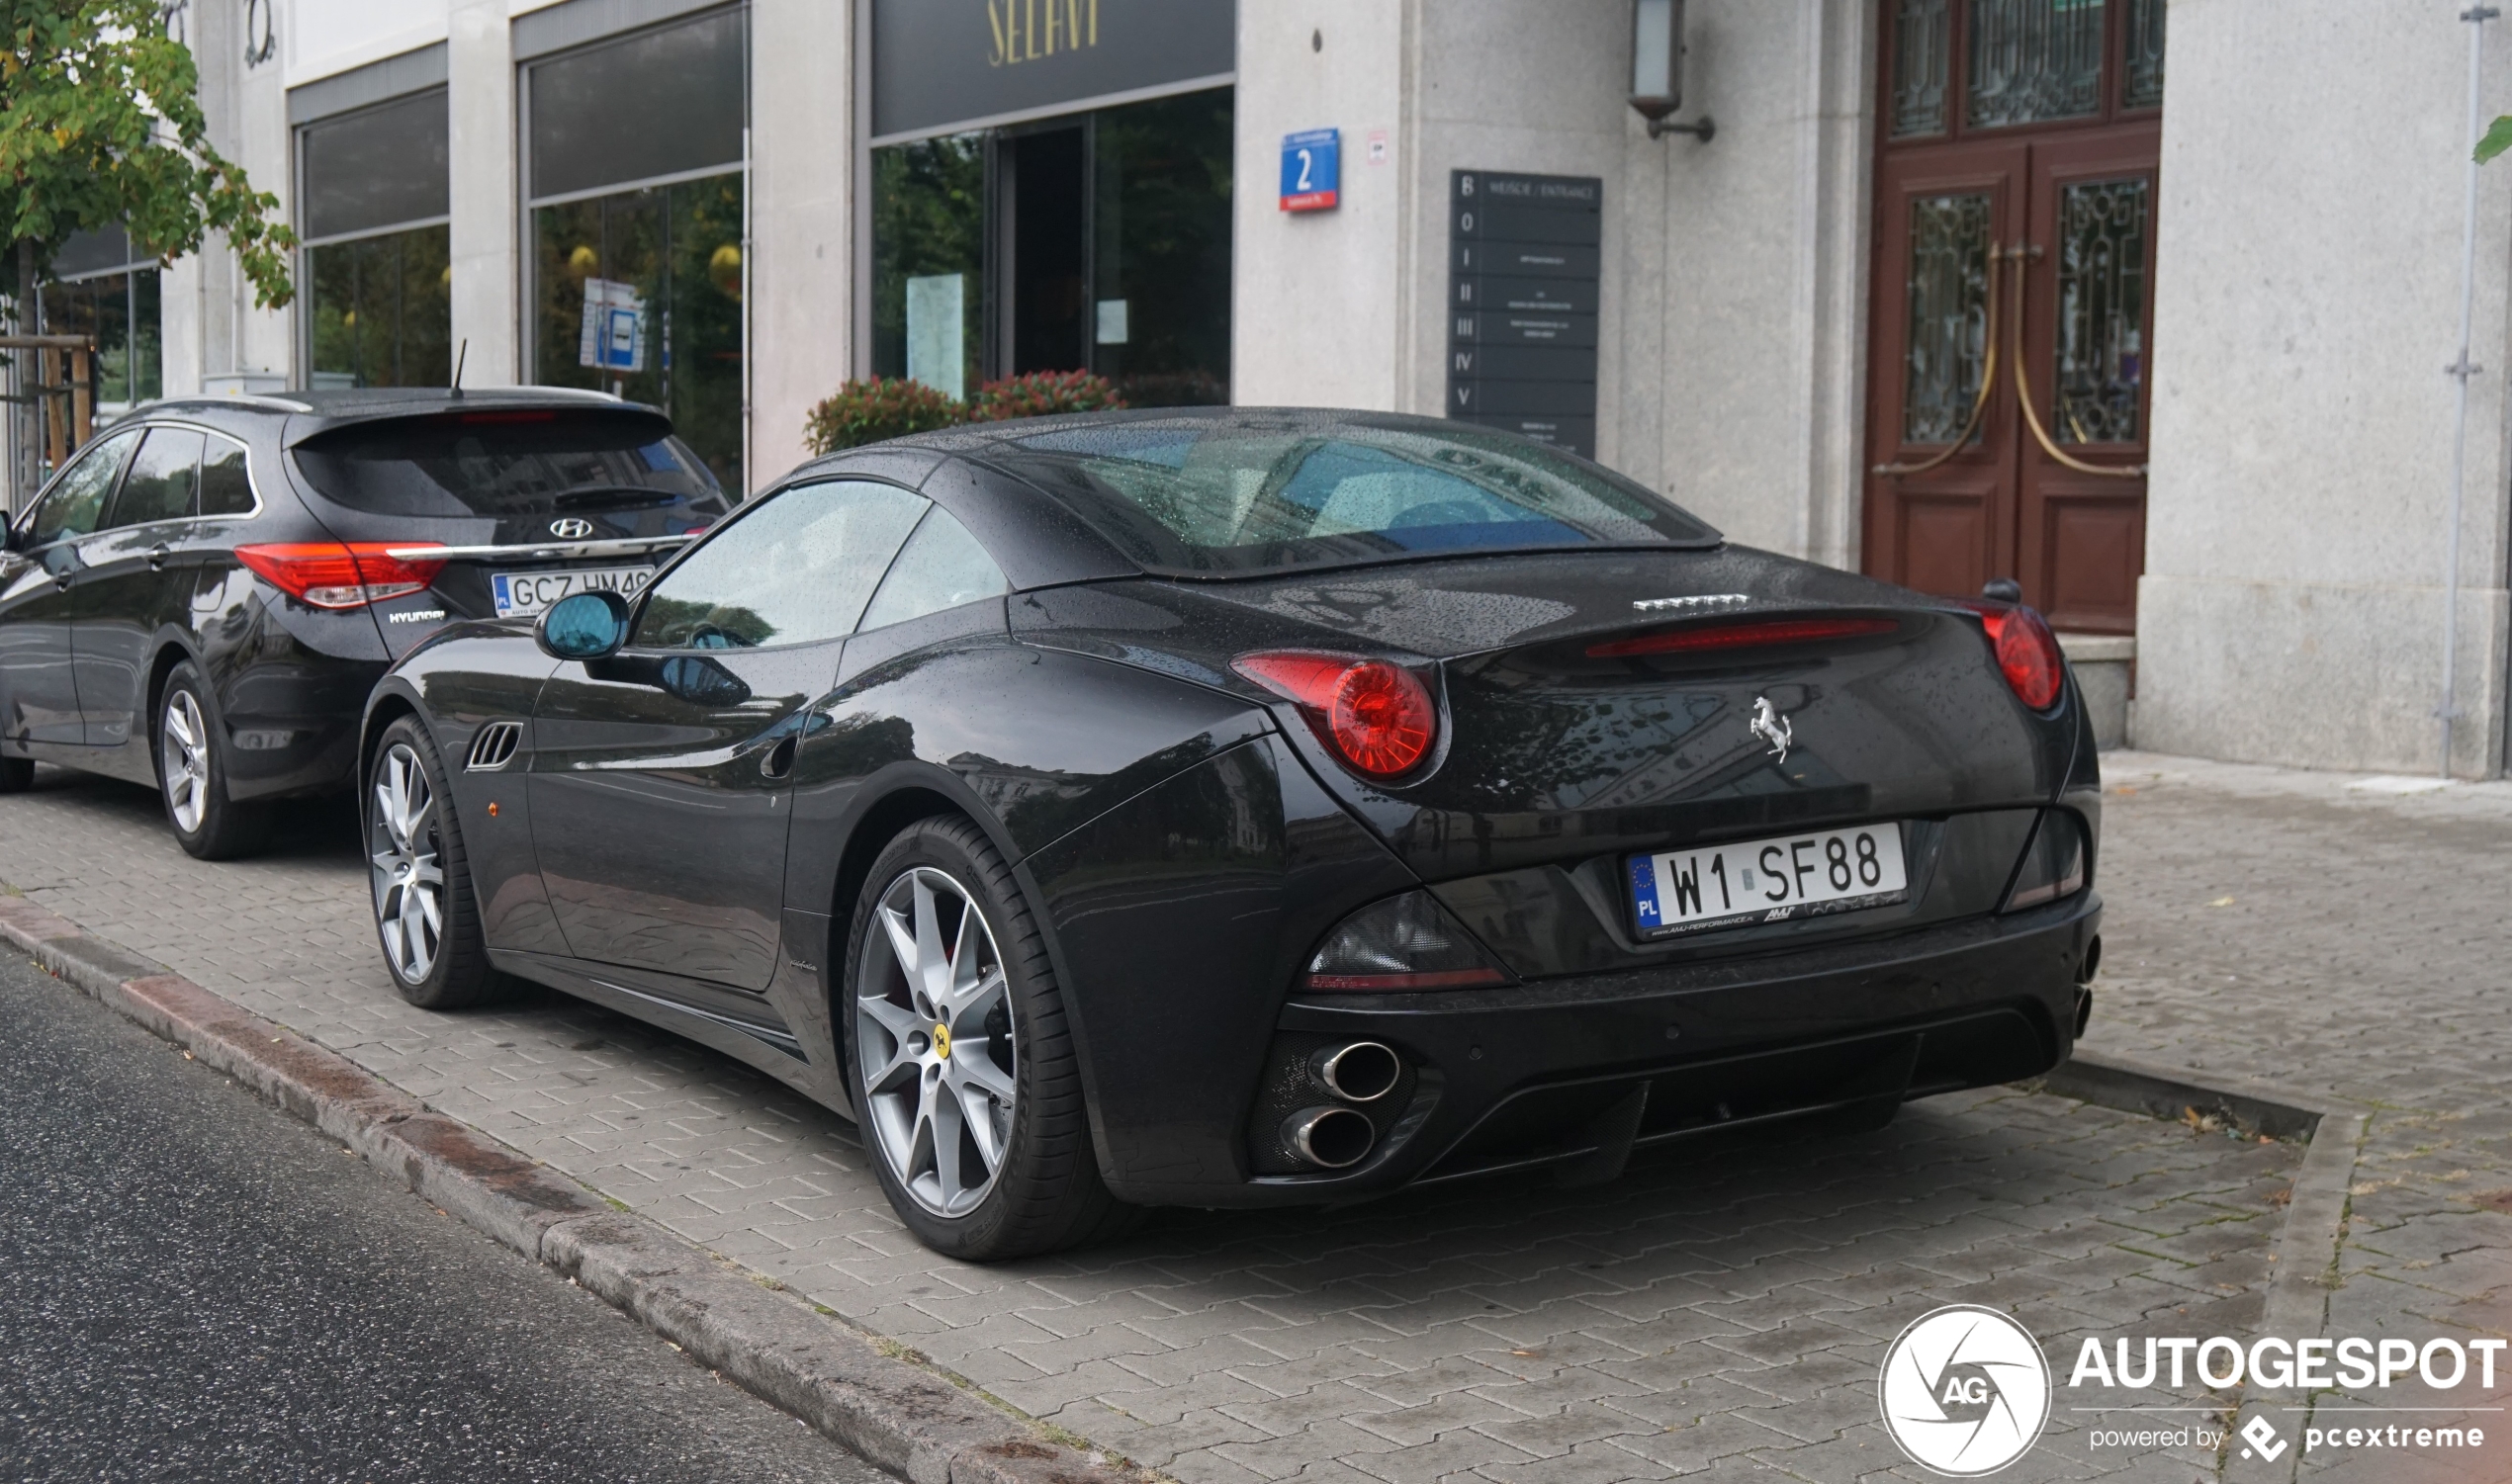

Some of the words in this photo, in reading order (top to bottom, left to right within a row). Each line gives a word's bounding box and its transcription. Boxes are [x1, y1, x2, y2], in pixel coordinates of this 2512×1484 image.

[1297, 148, 1312, 191] 2
[1461, 175, 1474, 197] B
[1458, 317, 1474, 336] III
[1456, 352, 1473, 372] IV
[1458, 387, 1471, 406] V
[513, 575, 572, 606] GCZ
[497, 596, 509, 607] PL
[389, 610, 445, 624] HYUNDAI
[1669, 853, 1731, 917] W1
[1759, 832, 1881, 902] SF88
[1638, 900, 1658, 917] PL
